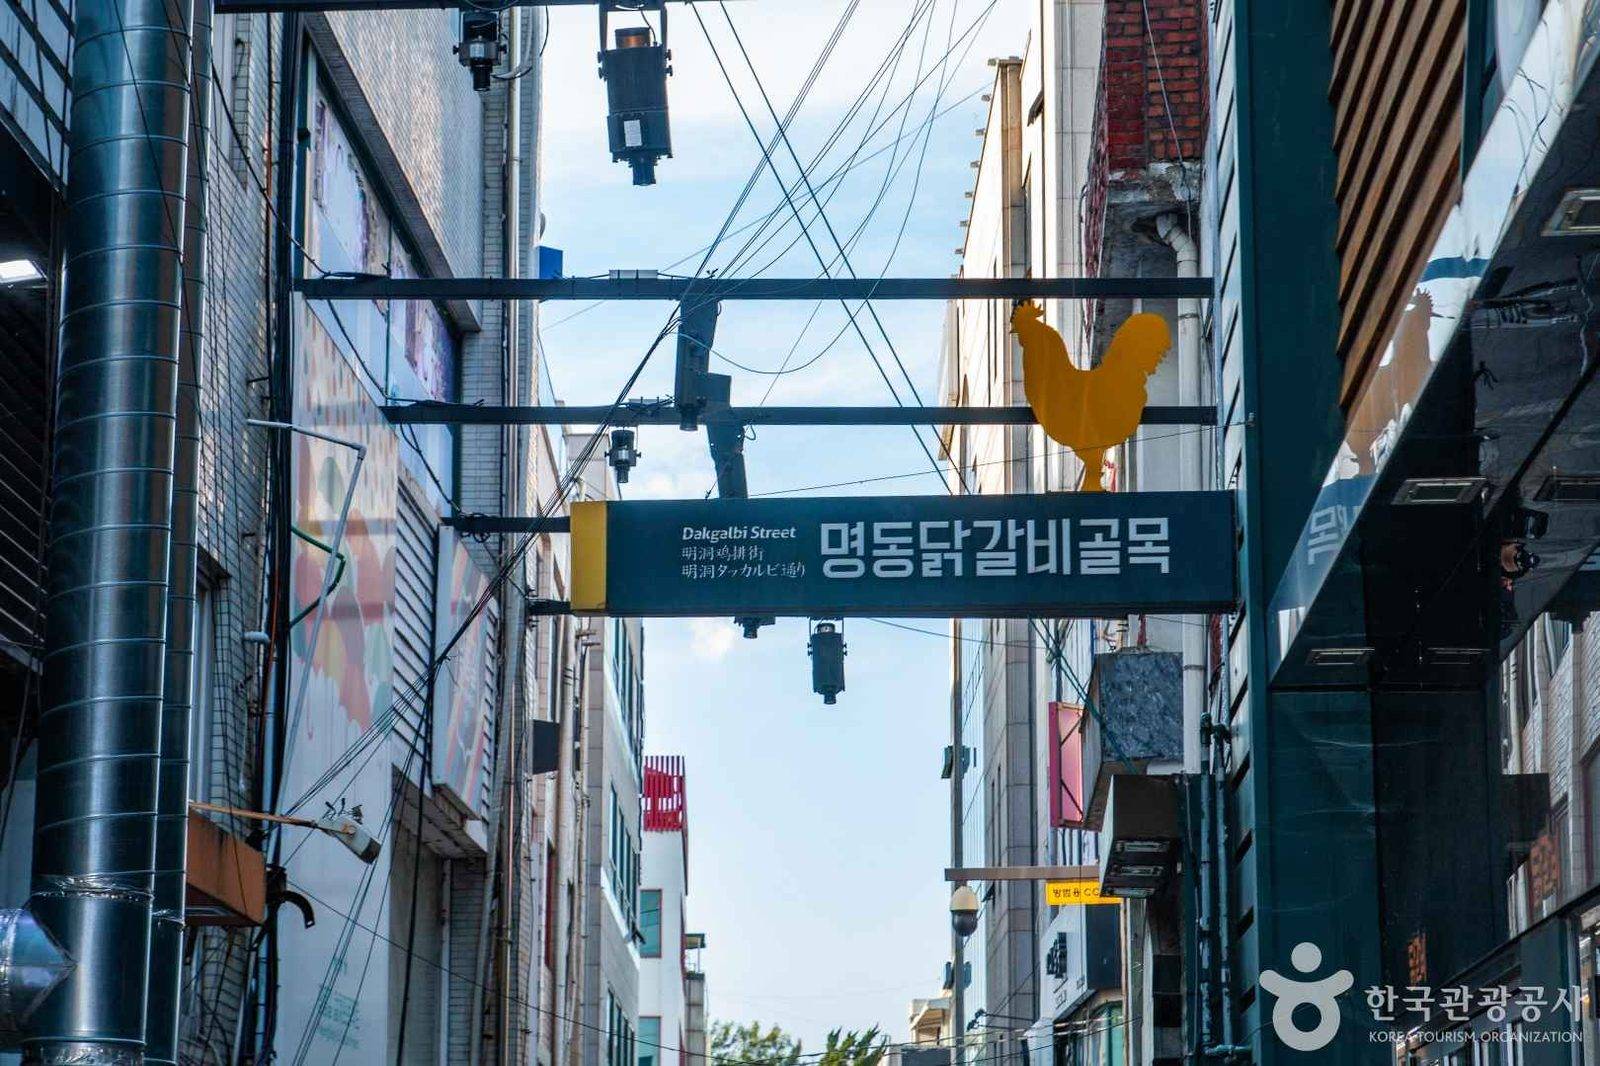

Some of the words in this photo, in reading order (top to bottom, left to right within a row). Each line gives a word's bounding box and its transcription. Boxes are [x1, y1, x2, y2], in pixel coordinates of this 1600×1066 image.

[682, 526, 748, 543] Dakgalbi
[750, 526, 797, 540] Street
[820, 517, 1171, 580] 명동닭갈비골목
[681, 561, 806, 579] 明洞タッカルビ通り
